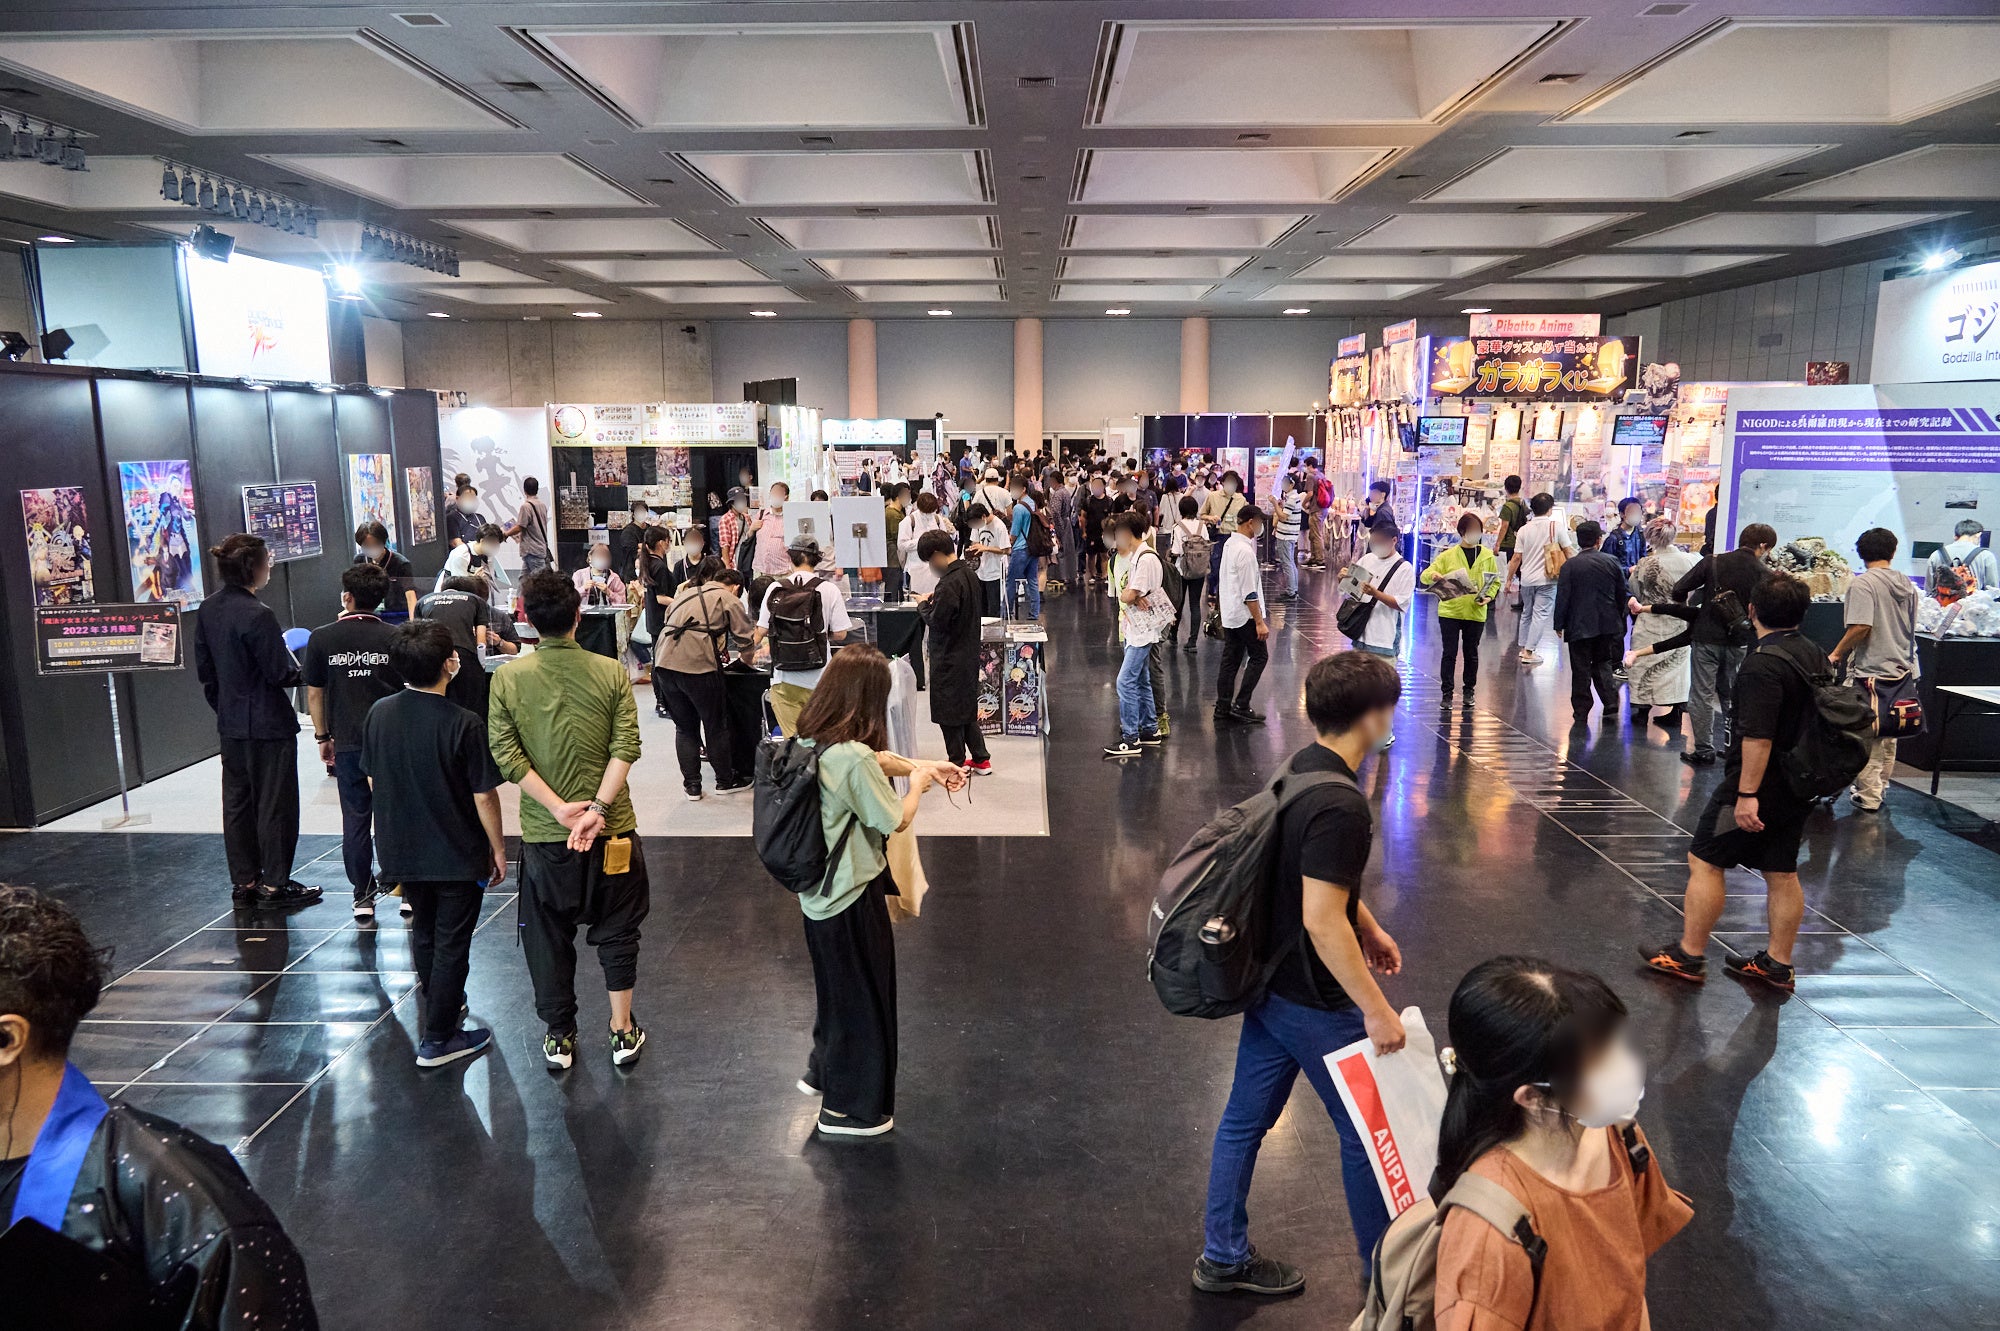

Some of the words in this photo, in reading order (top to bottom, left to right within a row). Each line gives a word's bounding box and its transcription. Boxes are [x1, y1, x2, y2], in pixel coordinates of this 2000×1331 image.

[1495, 319, 1535, 332] Pikatto
[1539, 319, 1574, 332] Anime
[1942, 351, 1982, 364] Godzilla
[1476, 358, 1588, 393] ガラガラくじ
[348, 669, 372, 678] STAFF
